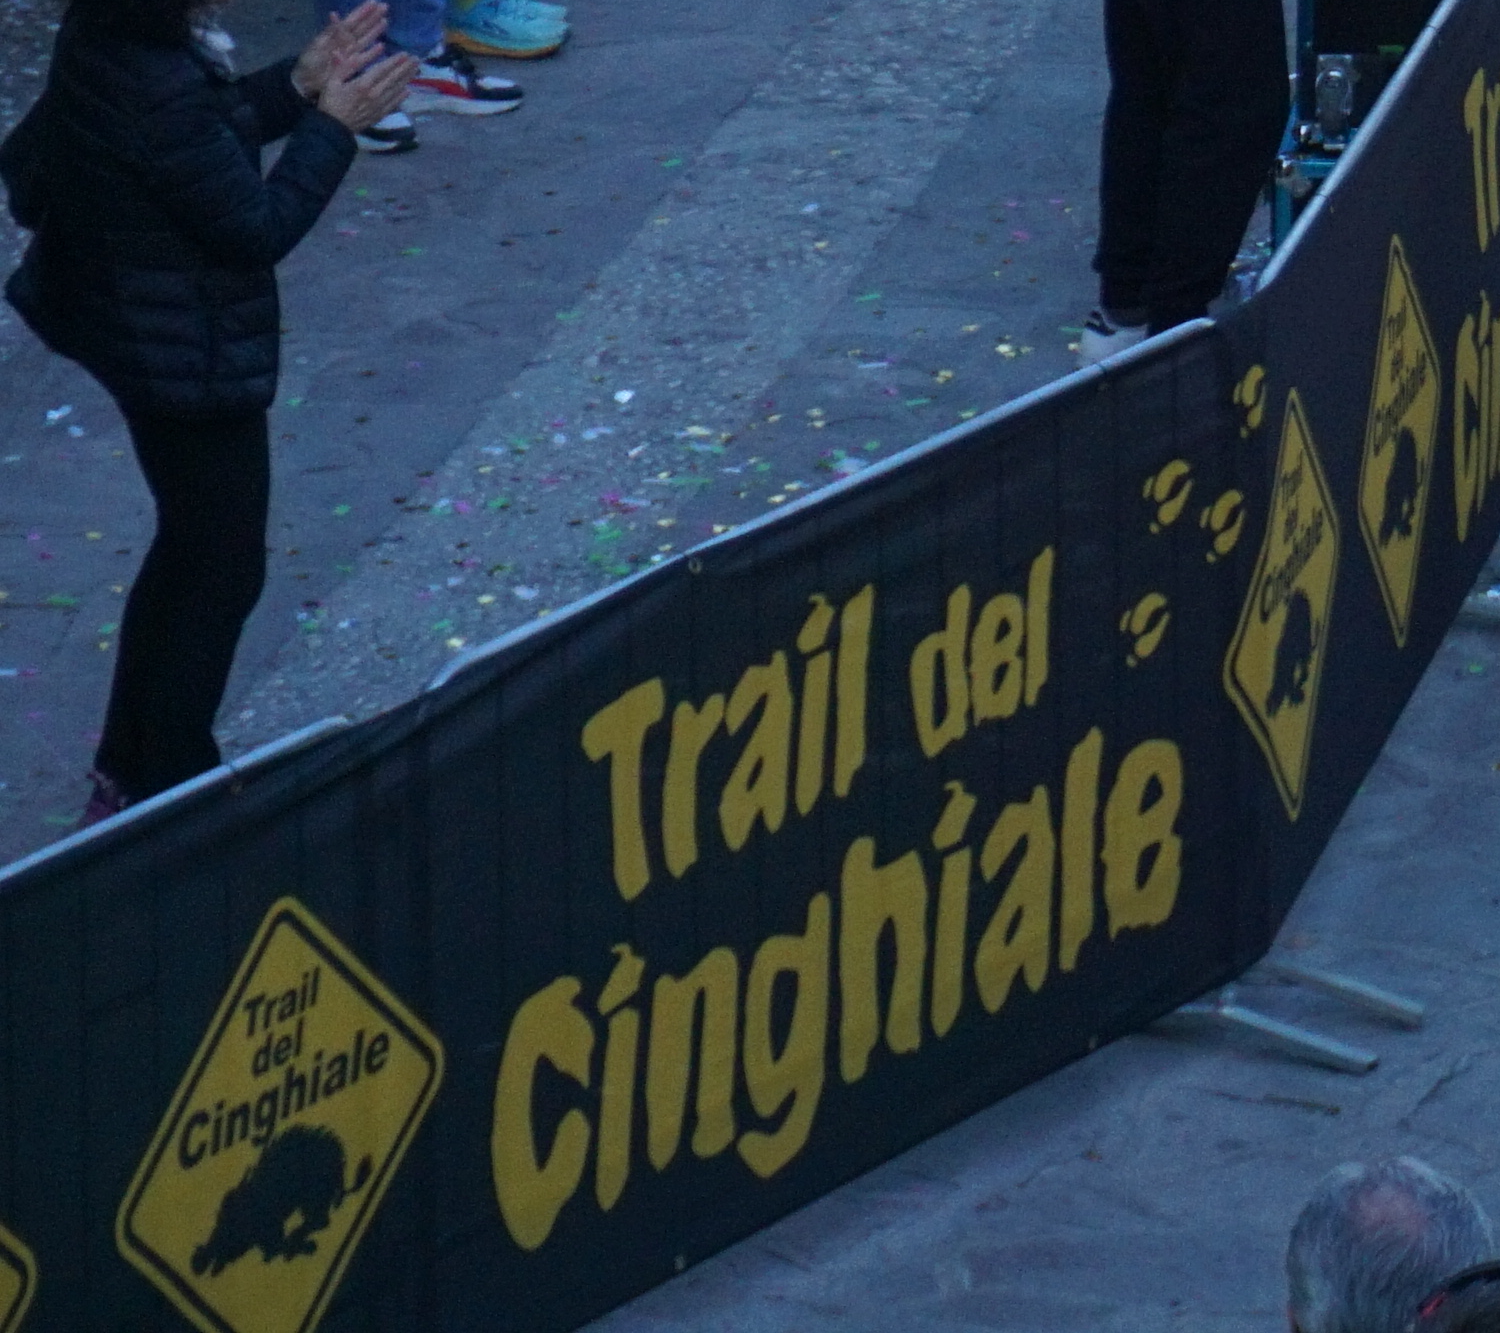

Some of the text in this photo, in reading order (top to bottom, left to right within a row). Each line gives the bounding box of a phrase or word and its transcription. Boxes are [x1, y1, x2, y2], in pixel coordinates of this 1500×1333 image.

[910, 549, 1053, 755] del
[583, 586, 881, 908] Trail
[242, 970, 321, 1040] Trail
[251, 1020, 304, 1076] del
[491, 722, 1183, 1250] Cinghiale
[179, 1032, 392, 1171] Cinghiale
